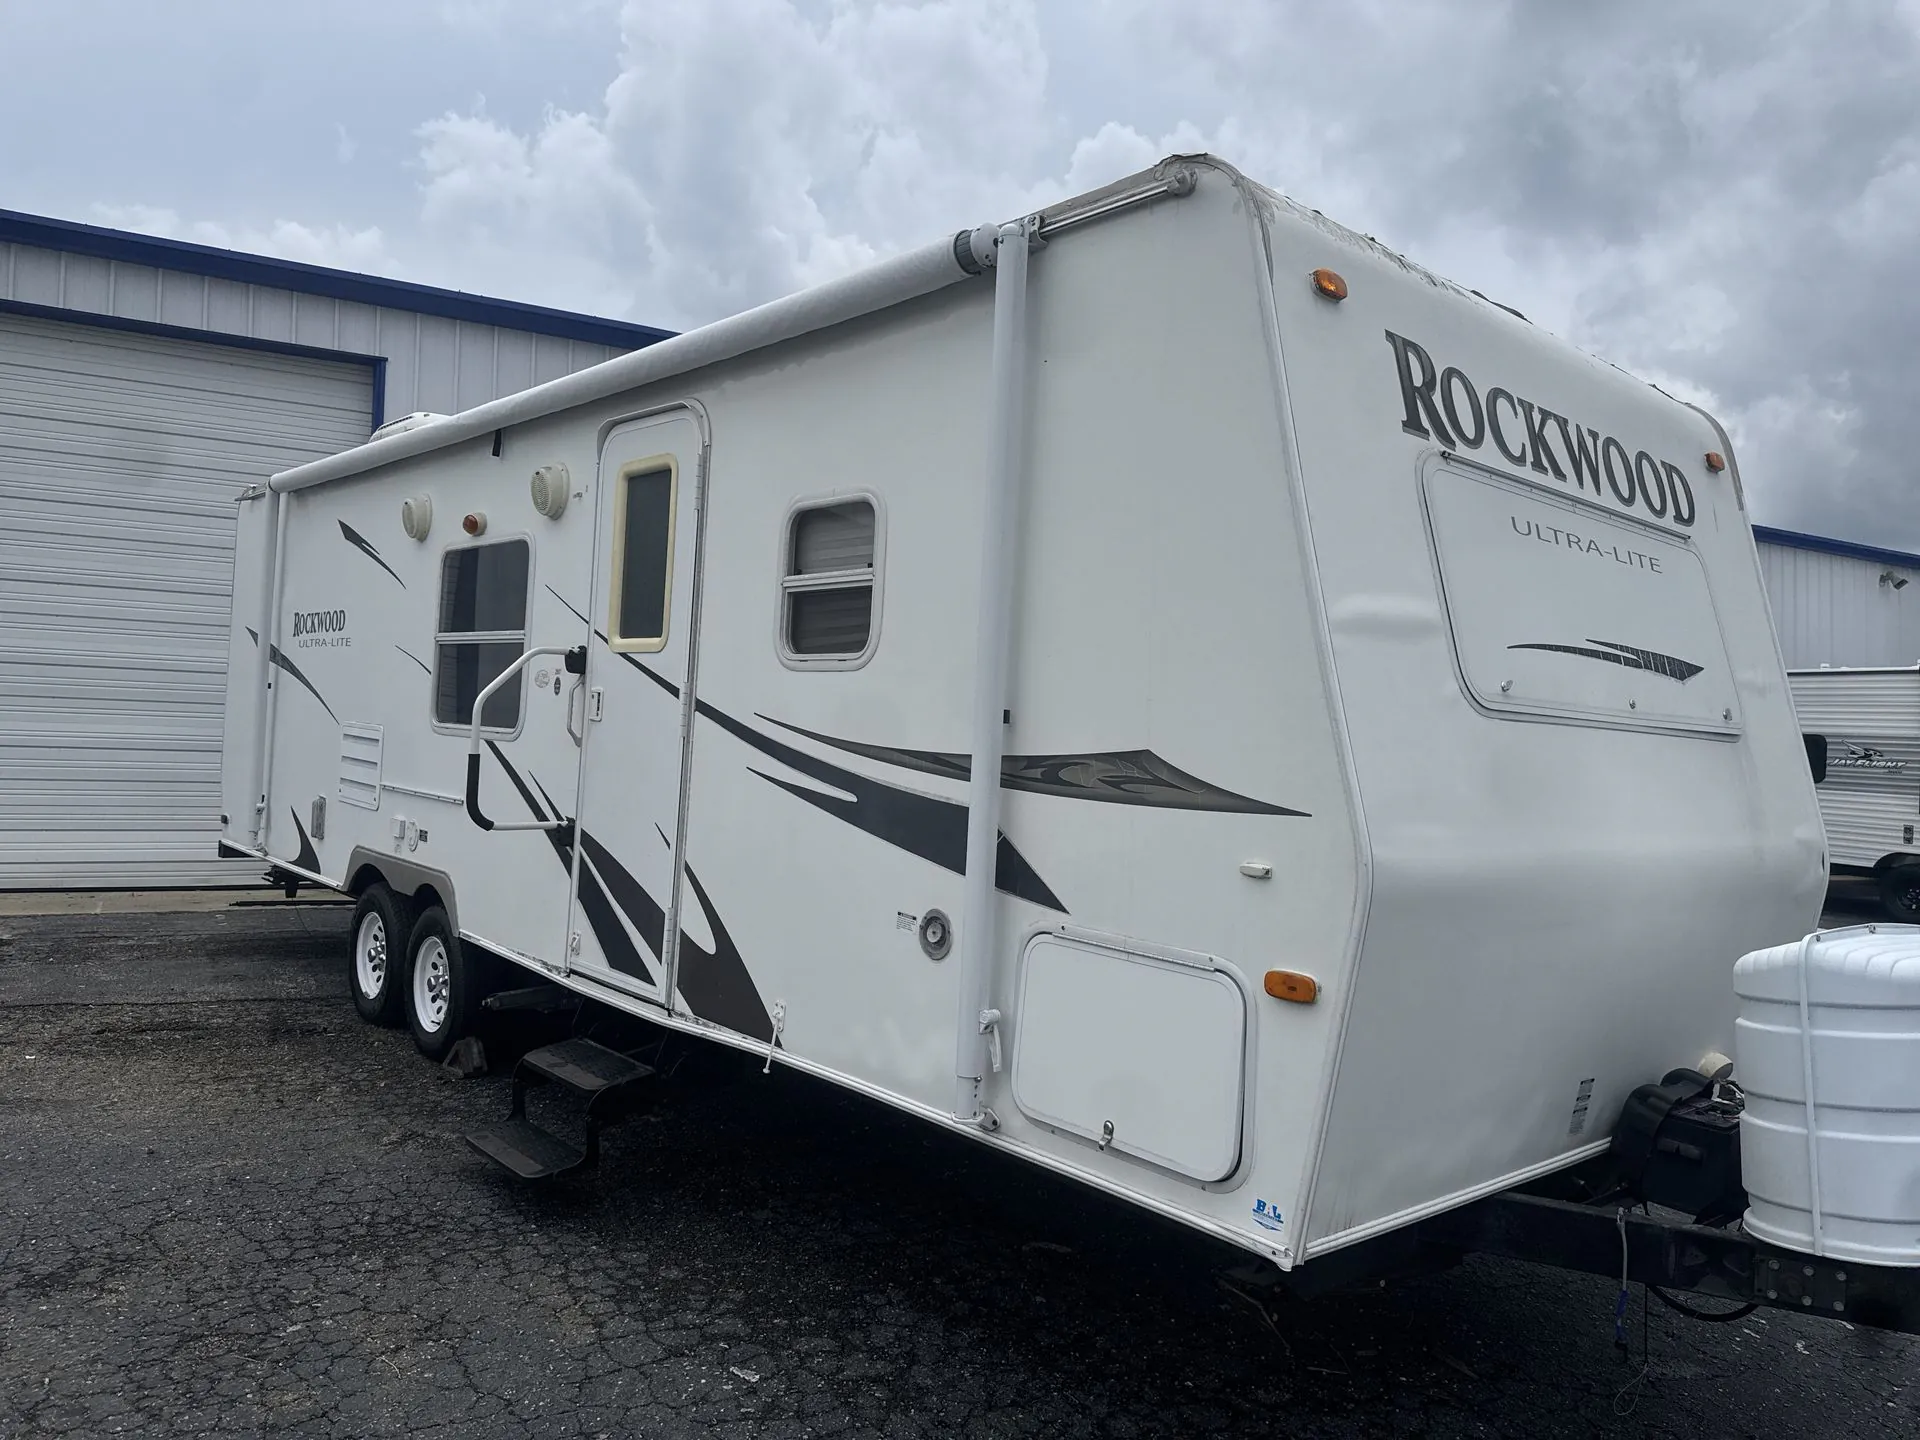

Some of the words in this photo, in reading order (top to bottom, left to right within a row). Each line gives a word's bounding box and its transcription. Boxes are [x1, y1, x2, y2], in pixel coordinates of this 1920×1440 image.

[1385, 329, 1695, 527] ROCKWOOD
[1511, 516, 1663, 574] ULTRA-LITE
[293, 610, 346, 637] ROCKWOOD
[299, 637, 352, 648] ULTRA-LITE
[1829, 758, 1854, 767] JAY
[1855, 759, 1906, 768] FLIGHT
